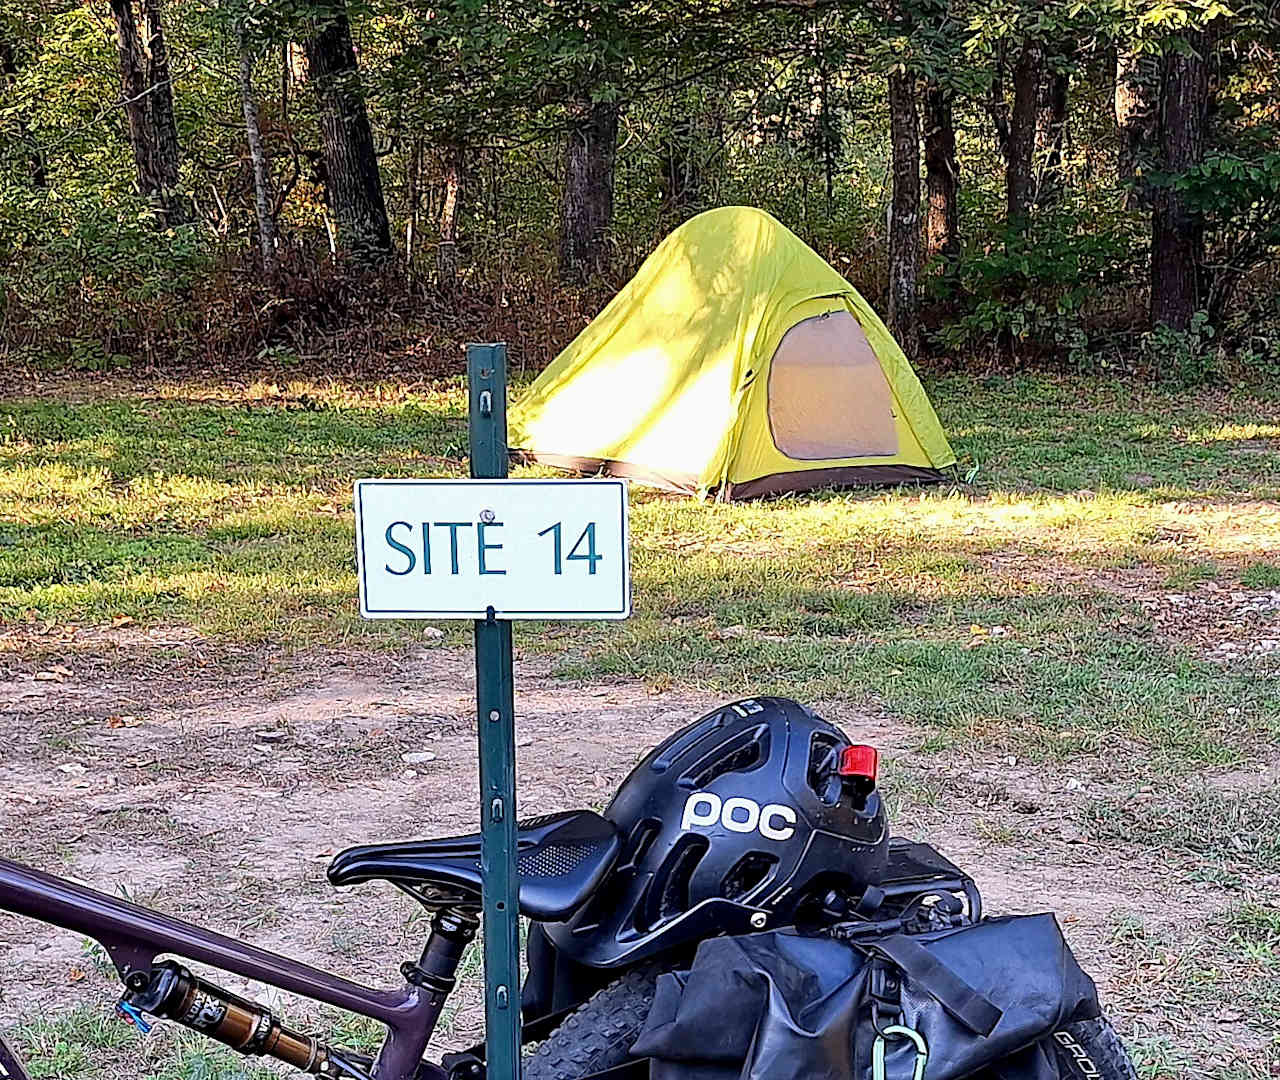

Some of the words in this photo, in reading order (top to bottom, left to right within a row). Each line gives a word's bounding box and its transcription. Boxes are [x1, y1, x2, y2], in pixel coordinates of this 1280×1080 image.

[384, 520, 508, 576] SITE
[537, 520, 603, 576] 14
[680, 792, 797, 841] POC
